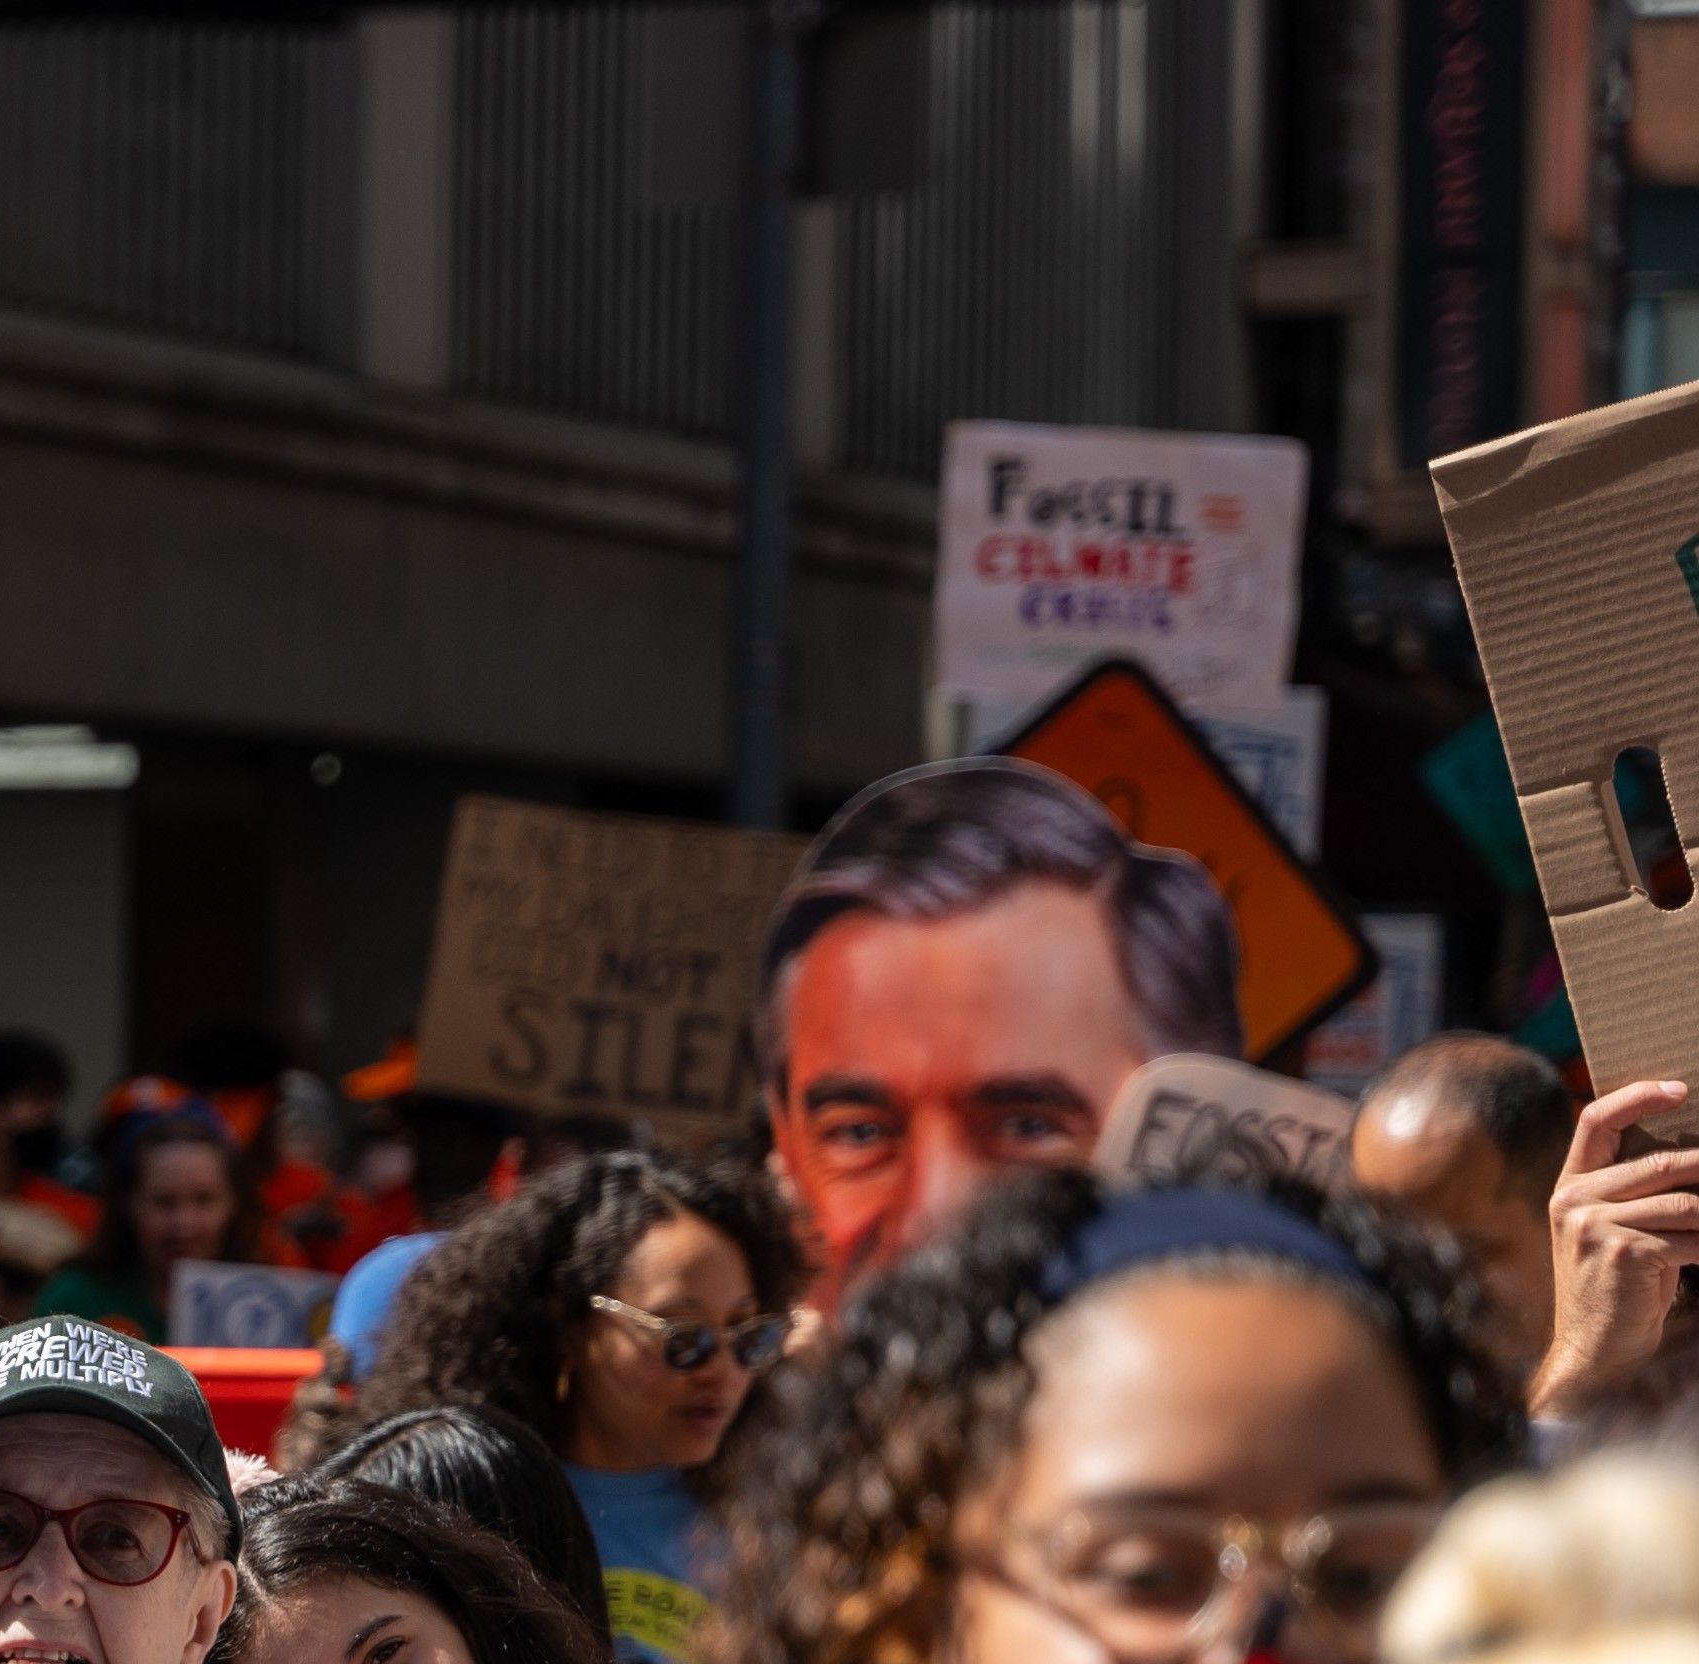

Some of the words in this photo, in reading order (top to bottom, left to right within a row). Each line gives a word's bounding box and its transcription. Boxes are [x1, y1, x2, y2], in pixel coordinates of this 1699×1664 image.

[595, 945, 723, 1005] NOT
[486, 985, 771, 1112] SILEN
[65, 1322, 148, 1368] WE'RE
[20, 1359, 154, 1398] MULTIPLY
